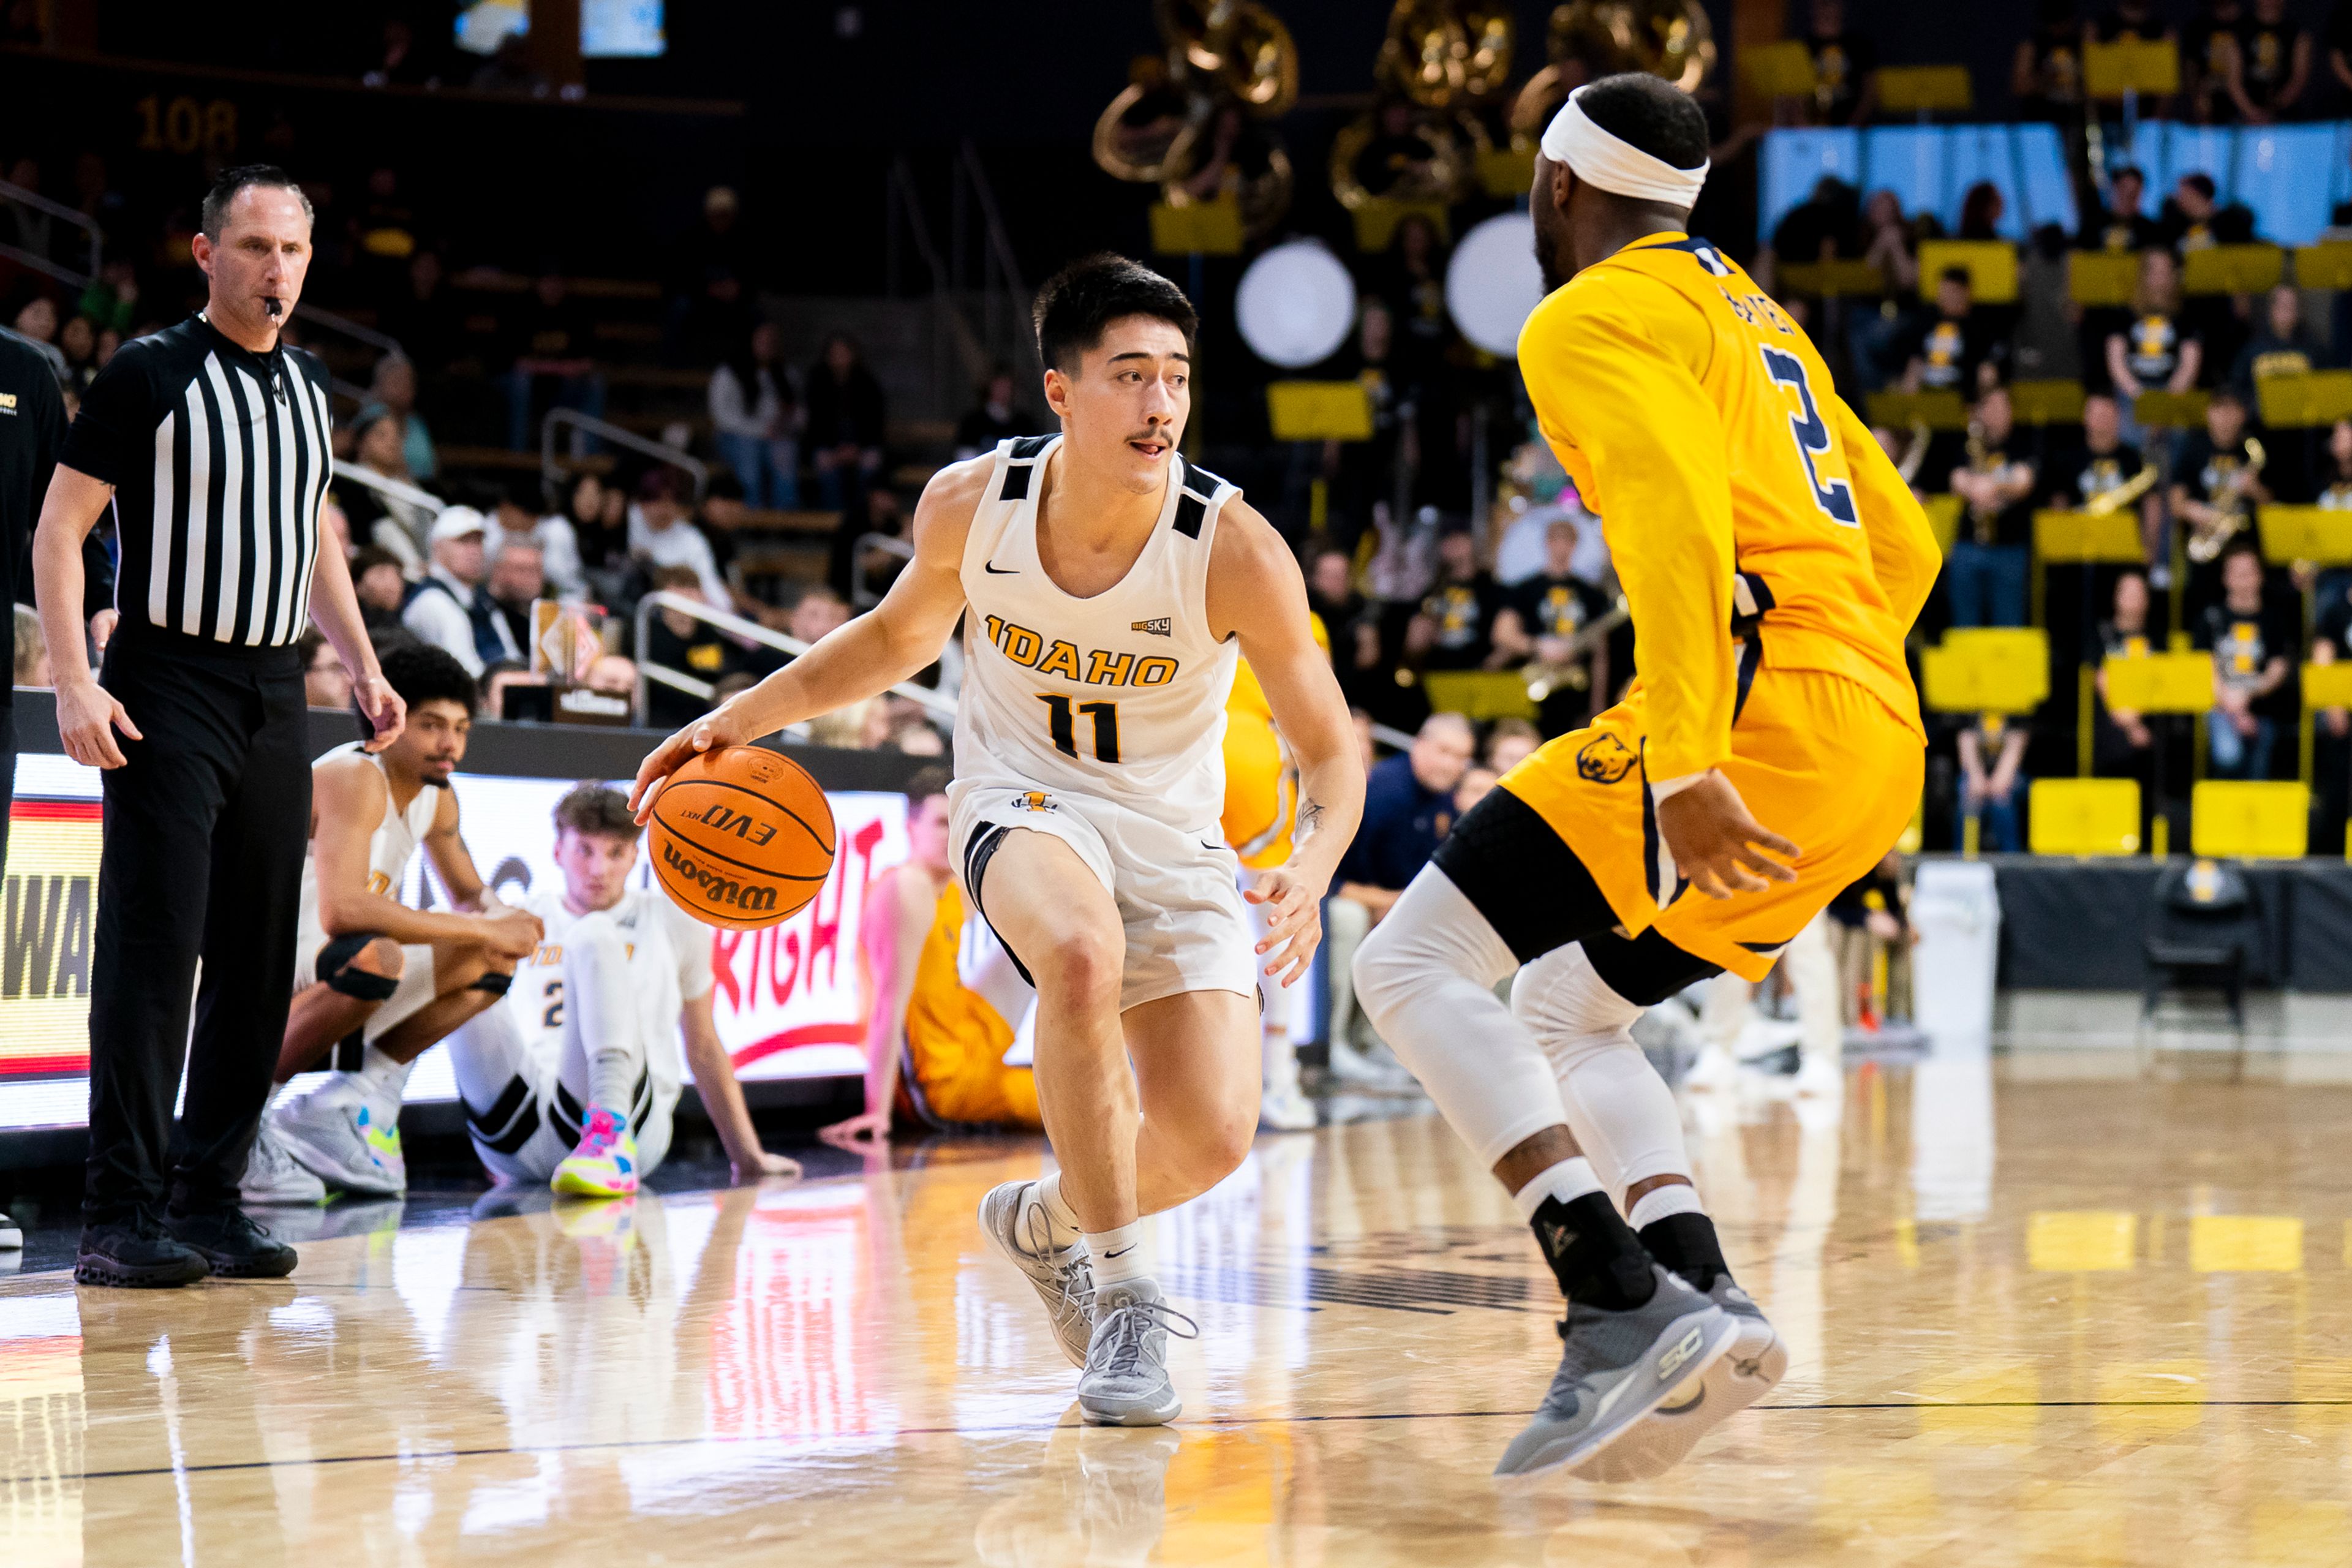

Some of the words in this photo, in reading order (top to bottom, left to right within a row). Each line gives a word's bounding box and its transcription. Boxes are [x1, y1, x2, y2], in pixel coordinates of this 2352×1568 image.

[135, 94, 238, 153] 108
[1758, 343, 1860, 528] 2
[984, 614, 1180, 687] IDAHO
[1033, 692, 1122, 764] 11
[680, 810, 702, 820] NXT
[664, 839, 777, 911] Wilson
